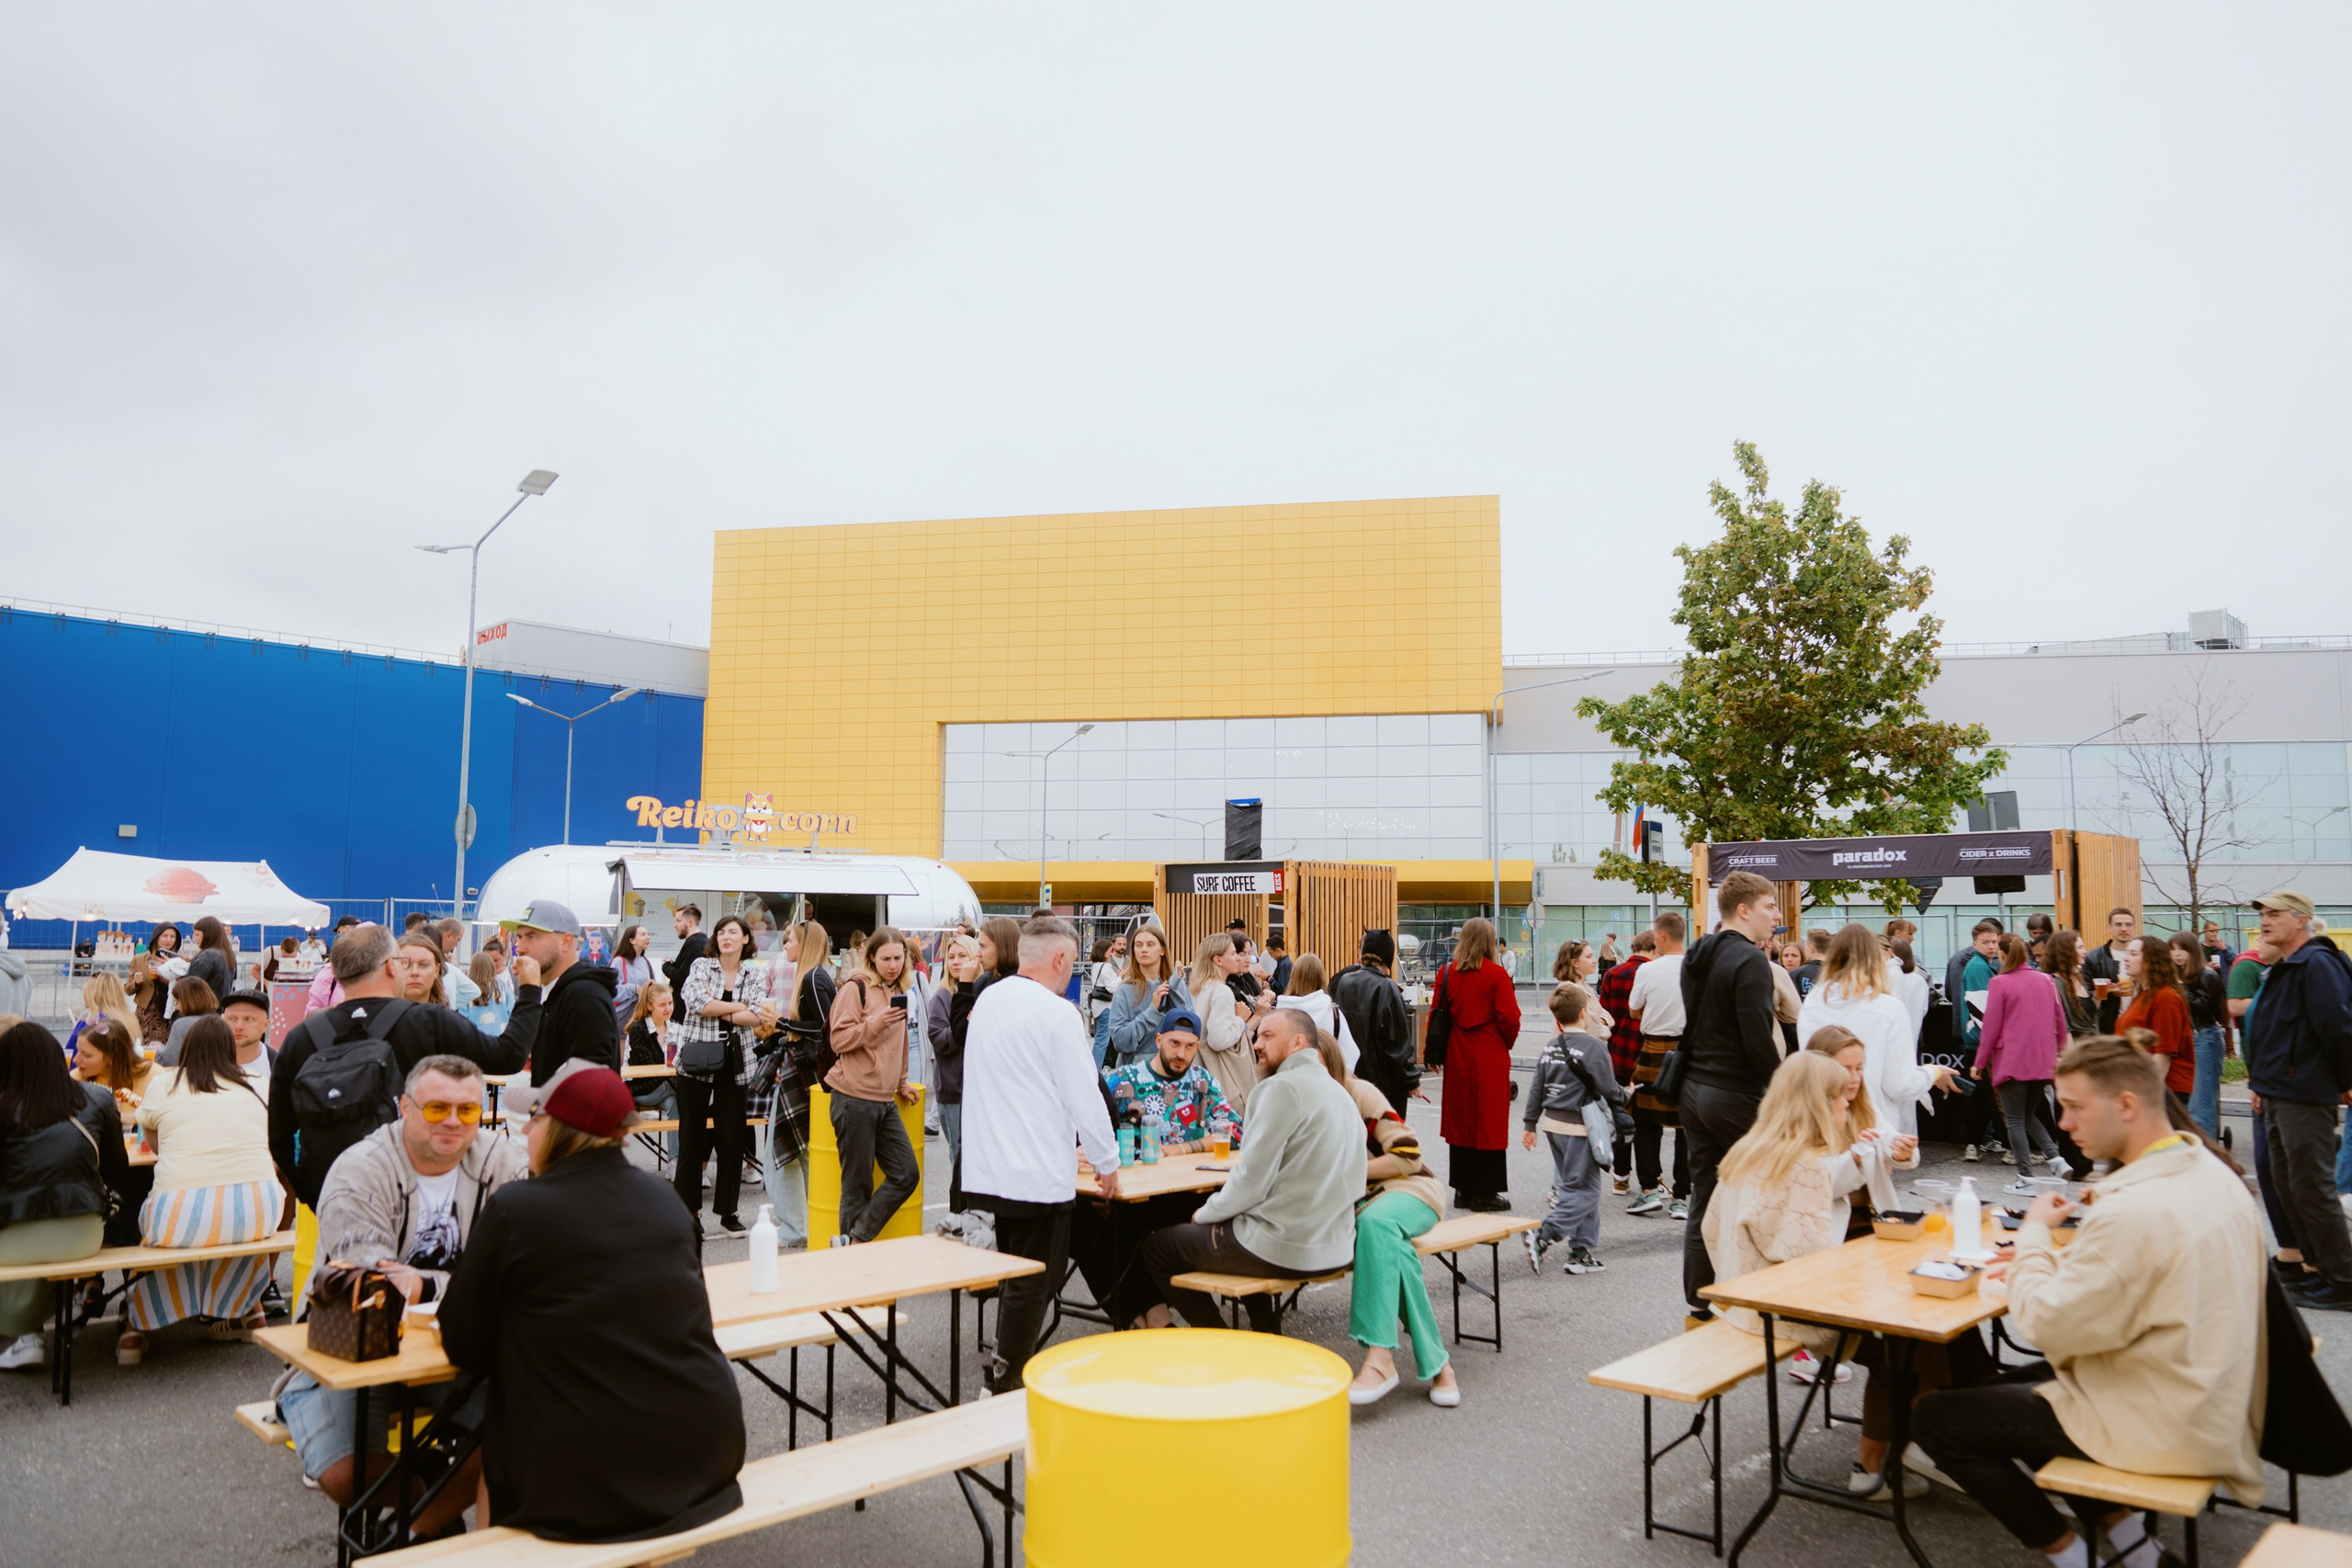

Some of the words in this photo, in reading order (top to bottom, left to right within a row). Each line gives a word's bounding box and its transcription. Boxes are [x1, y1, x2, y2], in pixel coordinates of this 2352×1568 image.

[477, 622, 507, 645] ВЫХОД
[626, 795, 738, 830] Reiko
[778, 811, 858, 834] corn
[1728, 857, 1754, 865] CRAFT
[1755, 856, 1777, 864] BEER
[1832, 847, 1907, 865] paradox
[1959, 850, 1987, 858] CIDER
[1996, 849, 2031, 857] DRINKS
[1196, 875, 1219, 893] SURF
[1222, 875, 1256, 892] COFFEE
[1273, 873, 1283, 891] KISS
